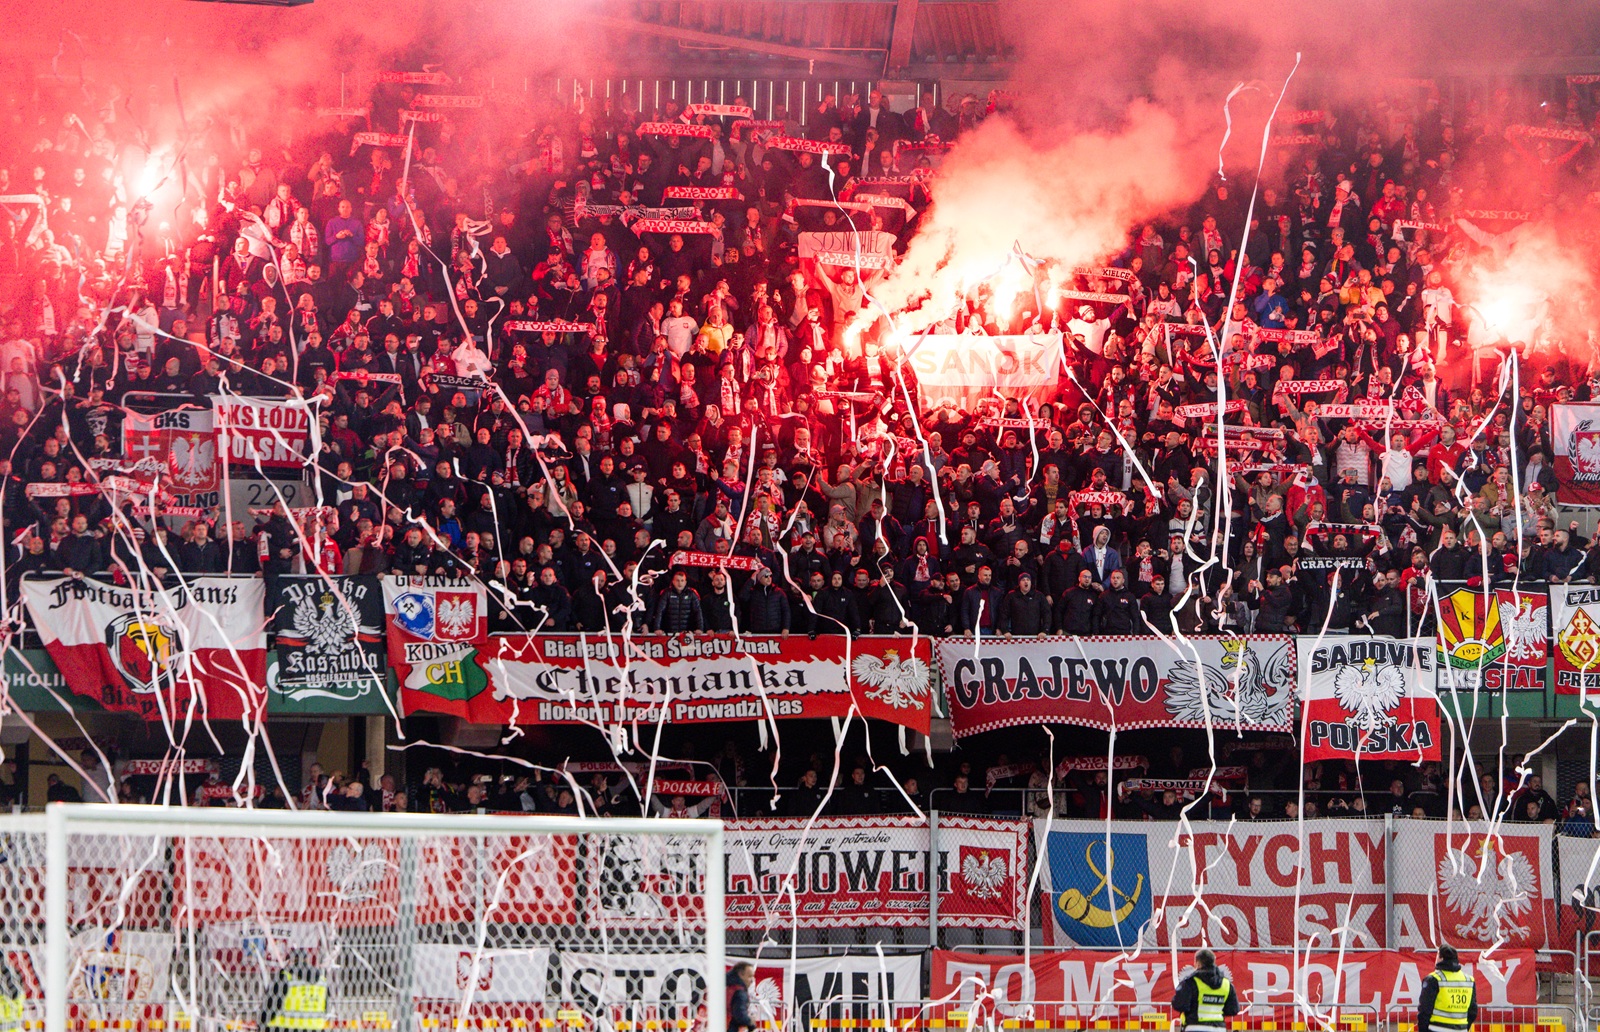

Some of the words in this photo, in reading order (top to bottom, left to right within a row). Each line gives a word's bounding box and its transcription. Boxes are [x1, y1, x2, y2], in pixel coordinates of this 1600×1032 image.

[696, 104, 716, 112] POL
[730, 106, 749, 114] SKA
[1466, 209, 1530, 220] POLSKA
[649, 221, 703, 232] POLSKA
[1103, 268, 1131, 280] KIELCE
[521, 321, 580, 331] POLSKA
[1262, 331, 1284, 339] SKA
[914, 350, 1046, 376] SANOK
[432, 374, 471, 386] JEBAĆ
[1281, 380, 1339, 393] POLSKA
[1189, 405, 1209, 415] POL
[1359, 398, 1418, 410] POLSKA
[1326, 406, 1349, 417] POL
[1360, 406, 1384, 417] SKA
[153, 412, 190, 429] GKS
[1359, 420, 1443, 431] POLSKA
[217, 434, 305, 463] POLSKA
[247, 484, 296, 506] 229
[166, 507, 201, 517] POLSKA
[1318, 524, 1370, 535] ARKA
[690, 555, 748, 567] POLSKA
[395, 575, 470, 587] GRNIK
[282, 576, 369, 603] Polska
[544, 640, 621, 659] Białego
[734, 639, 781, 655] Znak
[1462, 647, 1481, 656] 1922
[286, 651, 379, 674] Kaszubia
[1439, 647, 1504, 668] BLSKO-BAŁA
[305, 672, 359, 682] KOŚCIERZYNA
[426, 660, 465, 685] CH
[1438, 668, 1482, 688] BKS
[1485, 669, 1544, 689] STAL
[954, 655, 1159, 708] GRAJEWO
[539, 702, 610, 721] Honoru
[619, 703, 672, 723] Drogą
[676, 701, 763, 720] Prowadzi
[769, 700, 802, 715] Nas
[1310, 720, 1433, 753] POLSKA
[580, 761, 620, 770] POLSKA
[663, 781, 711, 794] POLSKA
[1141, 779, 1206, 791] STOMIL
[733, 835, 764, 850] mojej
[839, 831, 891, 848] potrzebie
[1180, 830, 1398, 887] TYCHY
[727, 899, 755, 912] krwi
[804, 900, 825, 911] ani
[829, 898, 859, 915] życia
[862, 898, 881, 909] nie
[1166, 902, 1430, 948] POLSKA
[945, 960, 1037, 1017] TO
[1059, 960, 1167, 1016] MY
[1247, 958, 1521, 1014] POLAY
[1451, 995, 1467, 1004] 130
